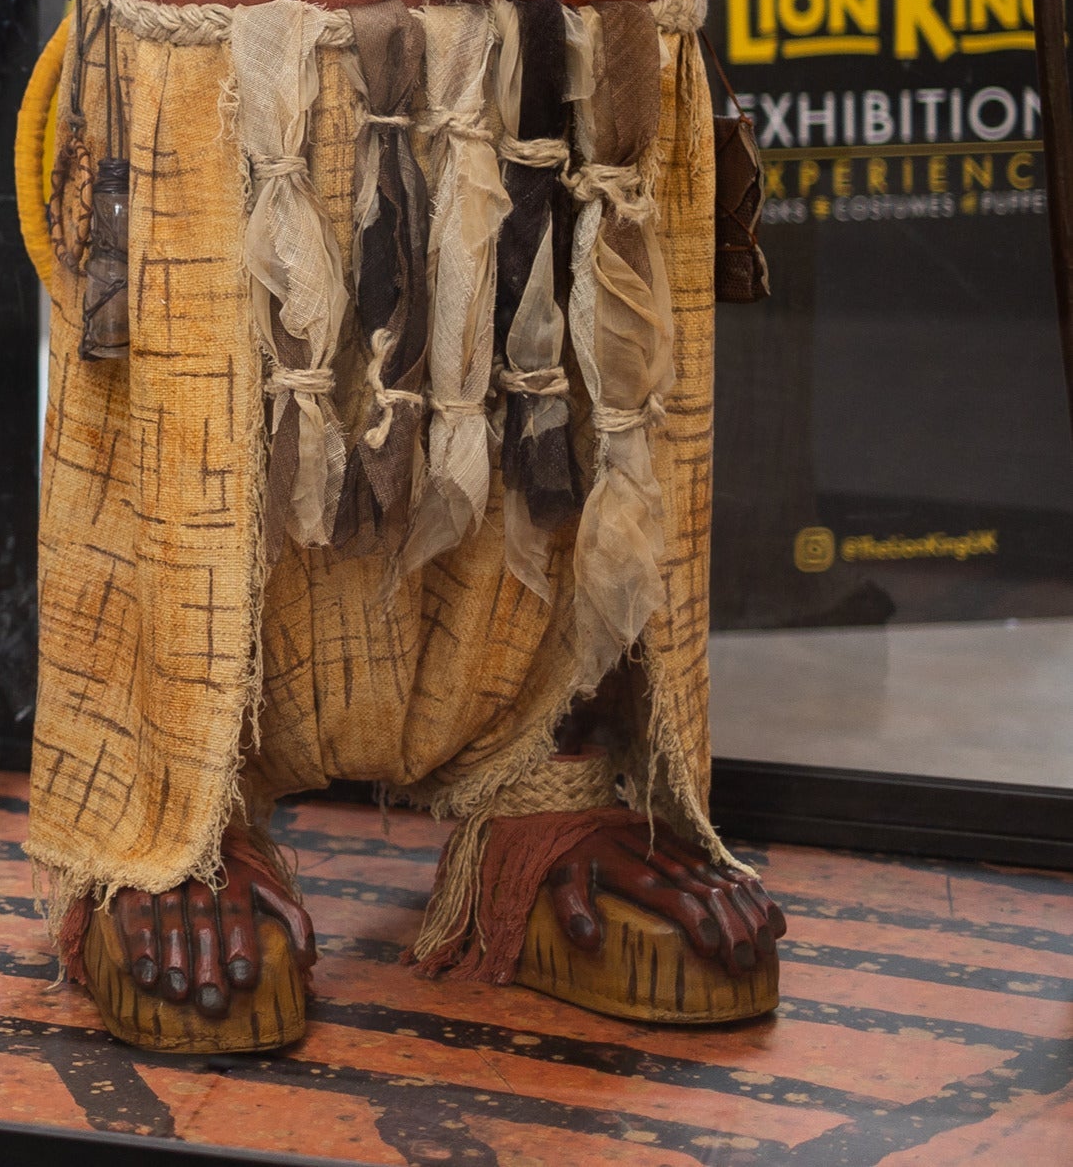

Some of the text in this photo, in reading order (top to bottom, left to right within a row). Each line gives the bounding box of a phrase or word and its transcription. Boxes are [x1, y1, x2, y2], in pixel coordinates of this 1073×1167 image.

[764, 153, 1035, 200] XPERIENC
[833, 192, 955, 222] COSTUMES
[980, 187, 1047, 217] PUPPE
